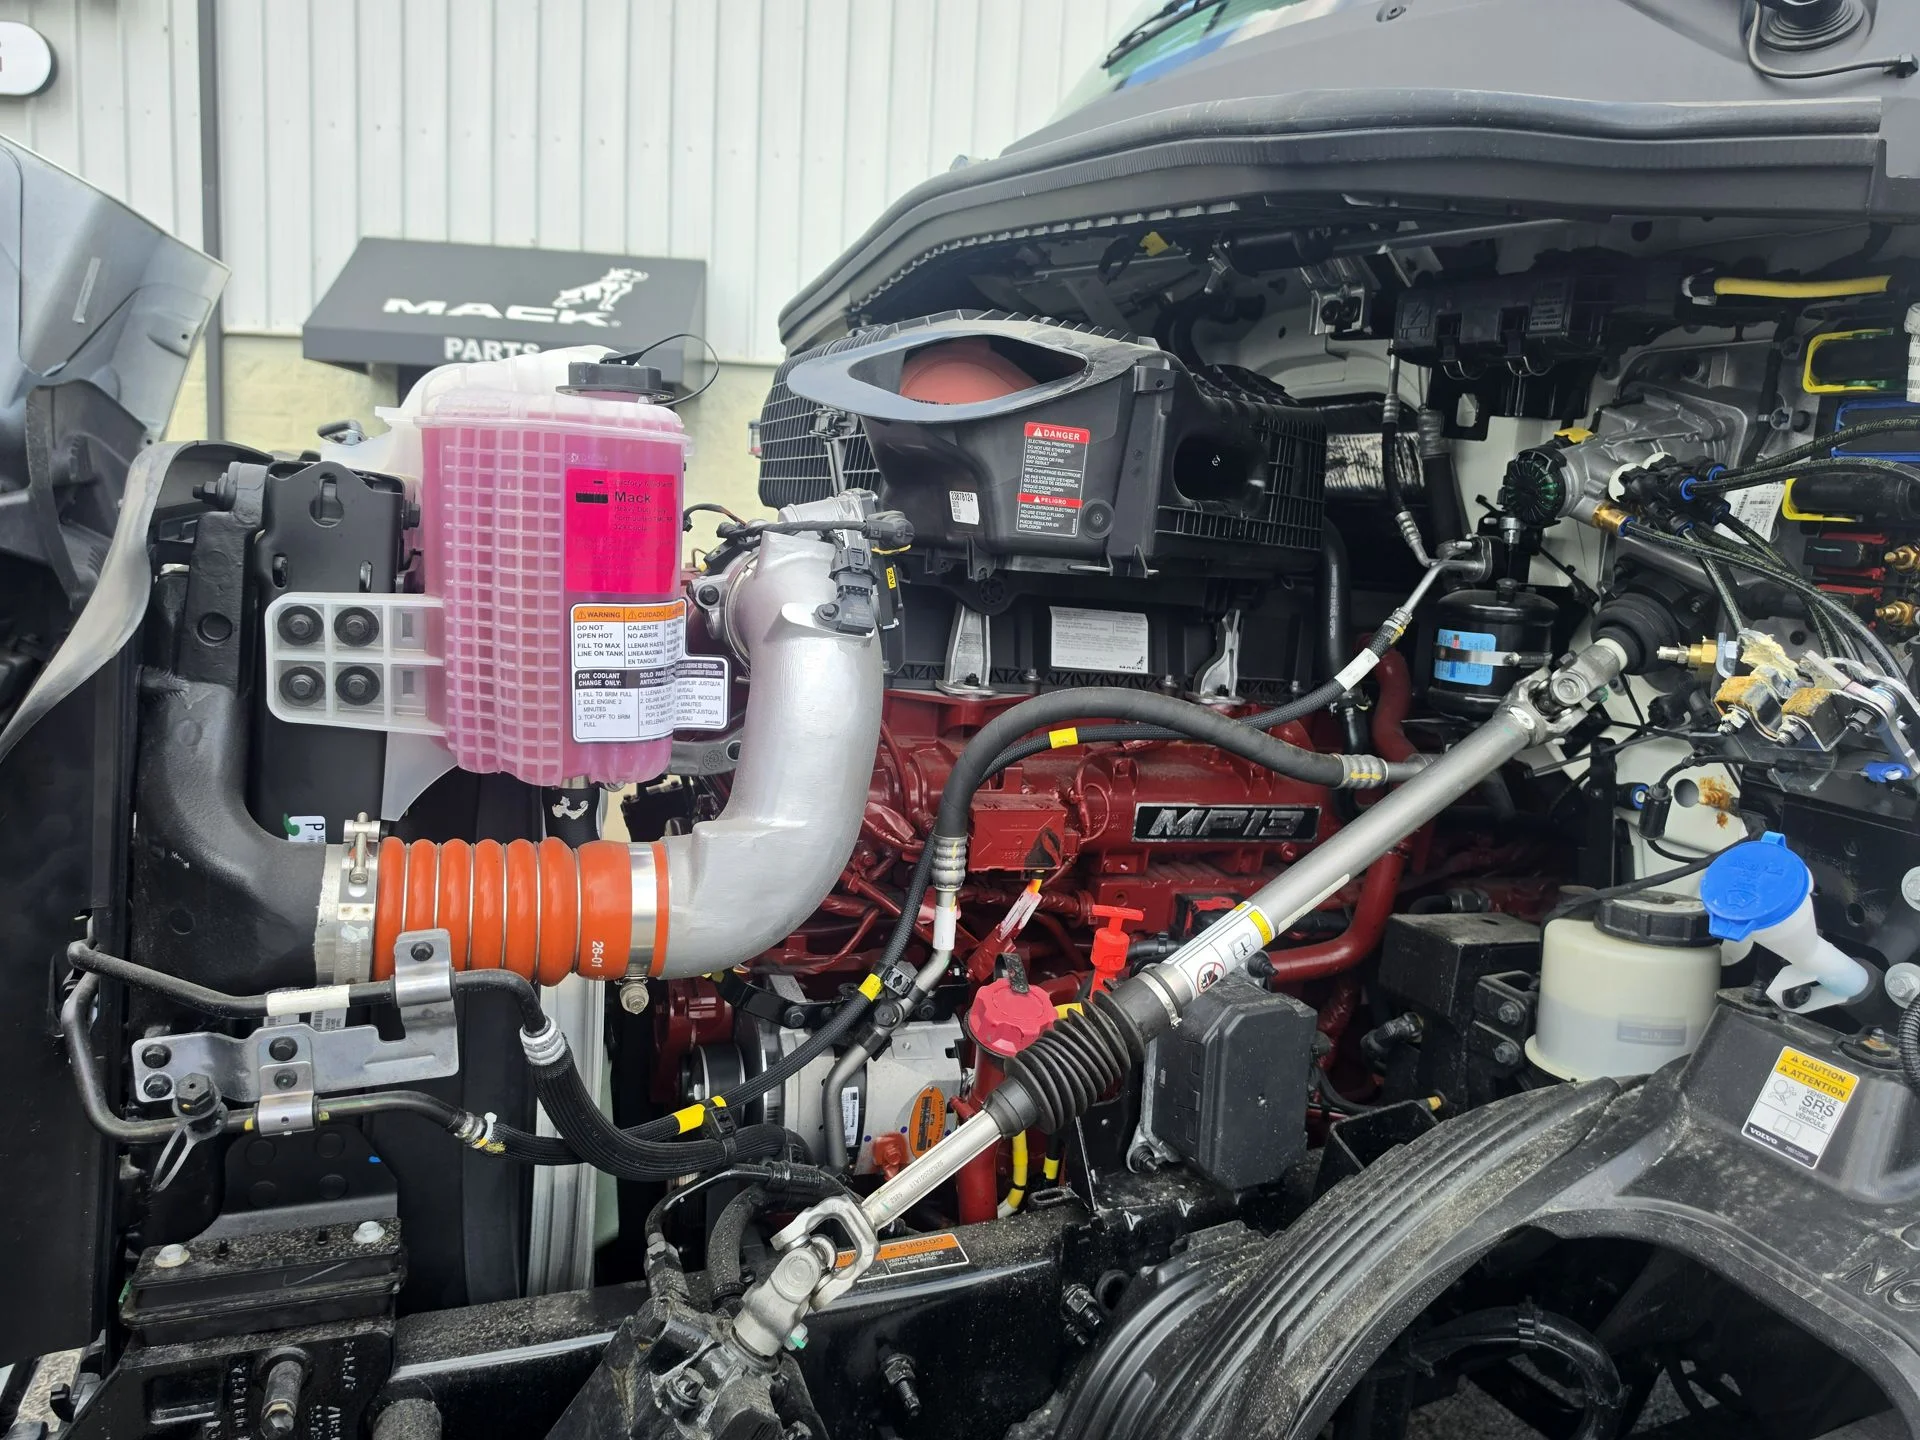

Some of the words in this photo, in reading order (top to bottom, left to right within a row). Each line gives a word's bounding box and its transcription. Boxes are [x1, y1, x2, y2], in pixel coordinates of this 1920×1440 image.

[382, 298, 609, 328] MACK
[1044, 429, 1080, 440] DANGER
[615, 491, 651, 503] Mack
[887, 570, 895, 585] 24V
[1147, 808, 1305, 837] MP13
[591, 940, 604, 968] 26-01
[1802, 1060, 1846, 1082] CAUTION
[1790, 1069, 1845, 1098] ATTENTION
[1798, 1105, 1825, 1121] VEHICLE
[1802, 1095, 1836, 1117] SRS
[1750, 1127, 1778, 1145] VOLVO
[898, 1237, 944, 1250] CUIDADO
